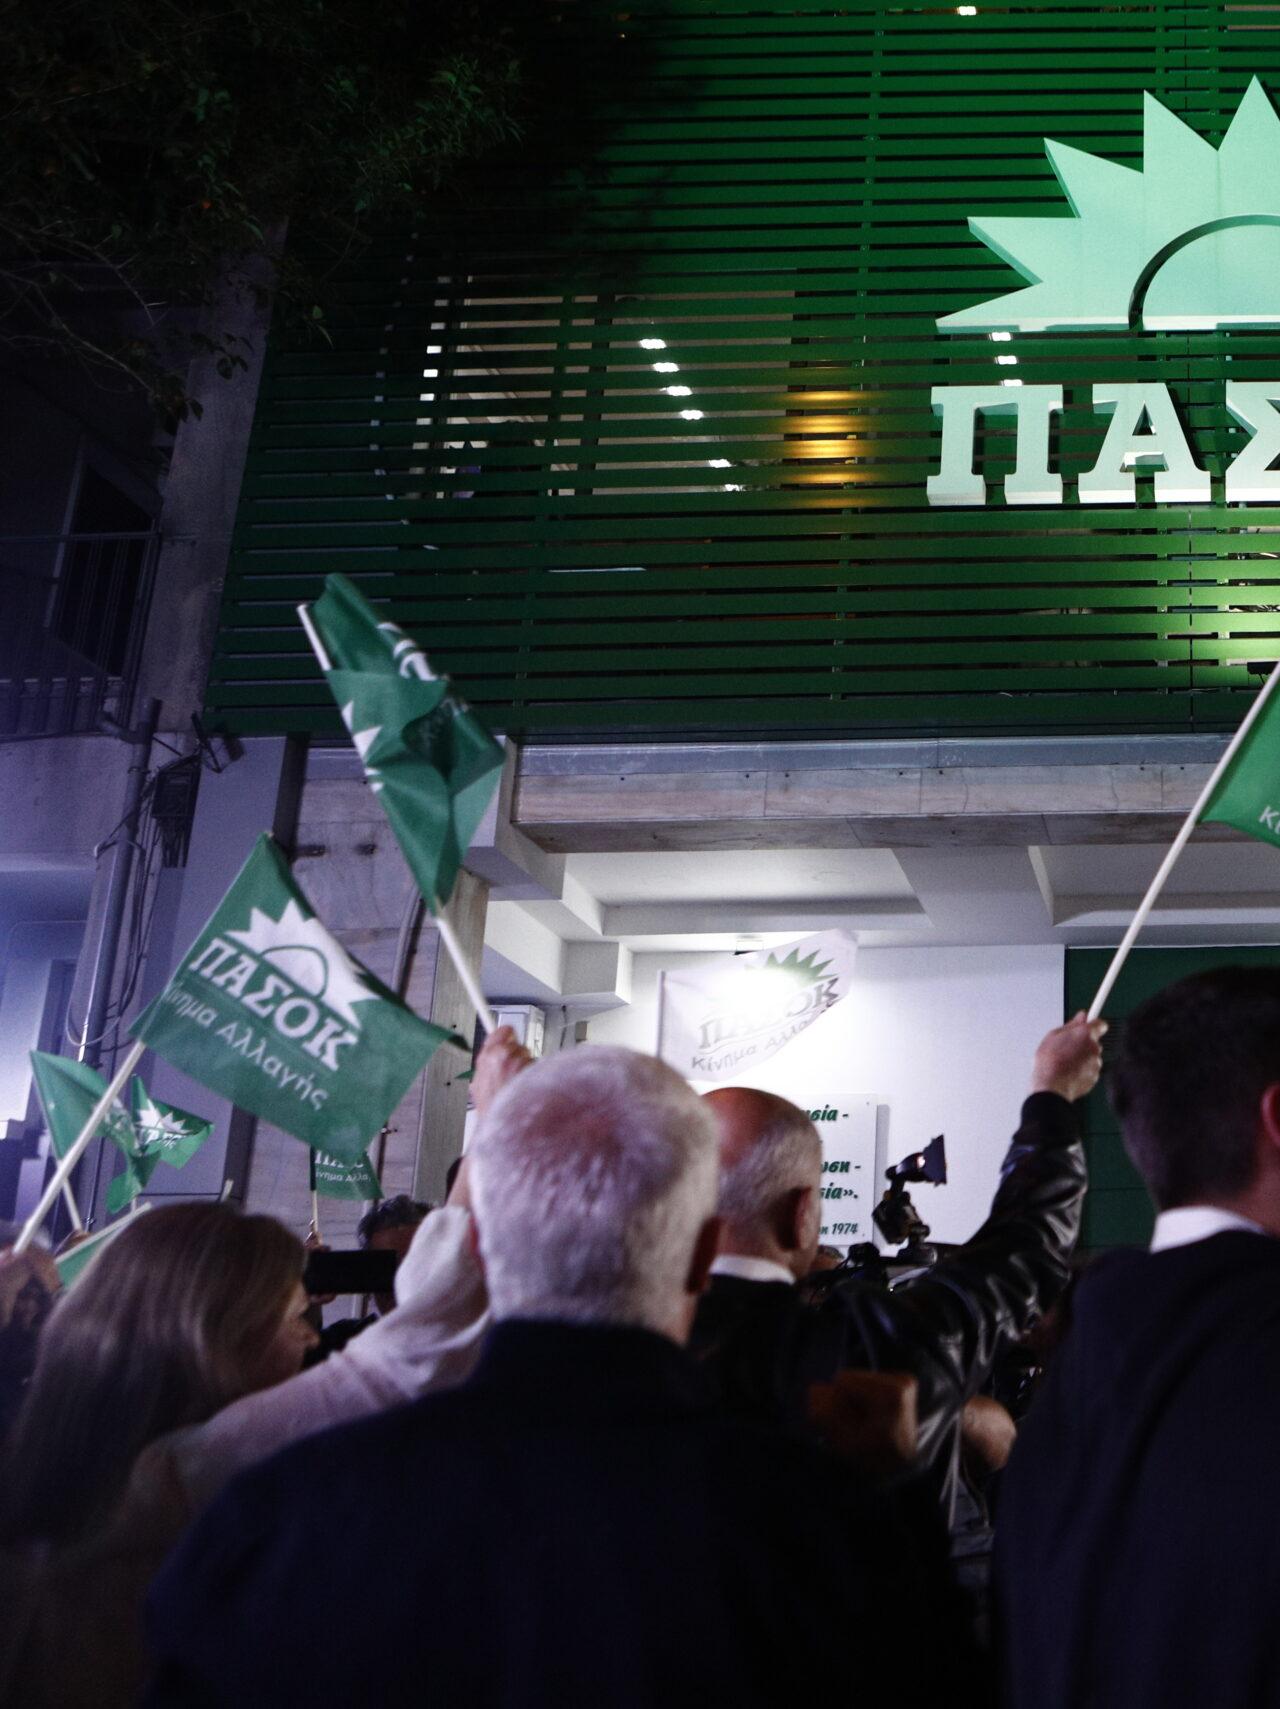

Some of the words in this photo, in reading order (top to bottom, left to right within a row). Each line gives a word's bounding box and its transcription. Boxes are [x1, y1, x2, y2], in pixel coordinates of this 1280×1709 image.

[188, 937, 359, 1072] ΠΑΣΟΚ
[216, 1021, 329, 1111] Αλλαγής
[832, 1222, 859, 1236] 1974
